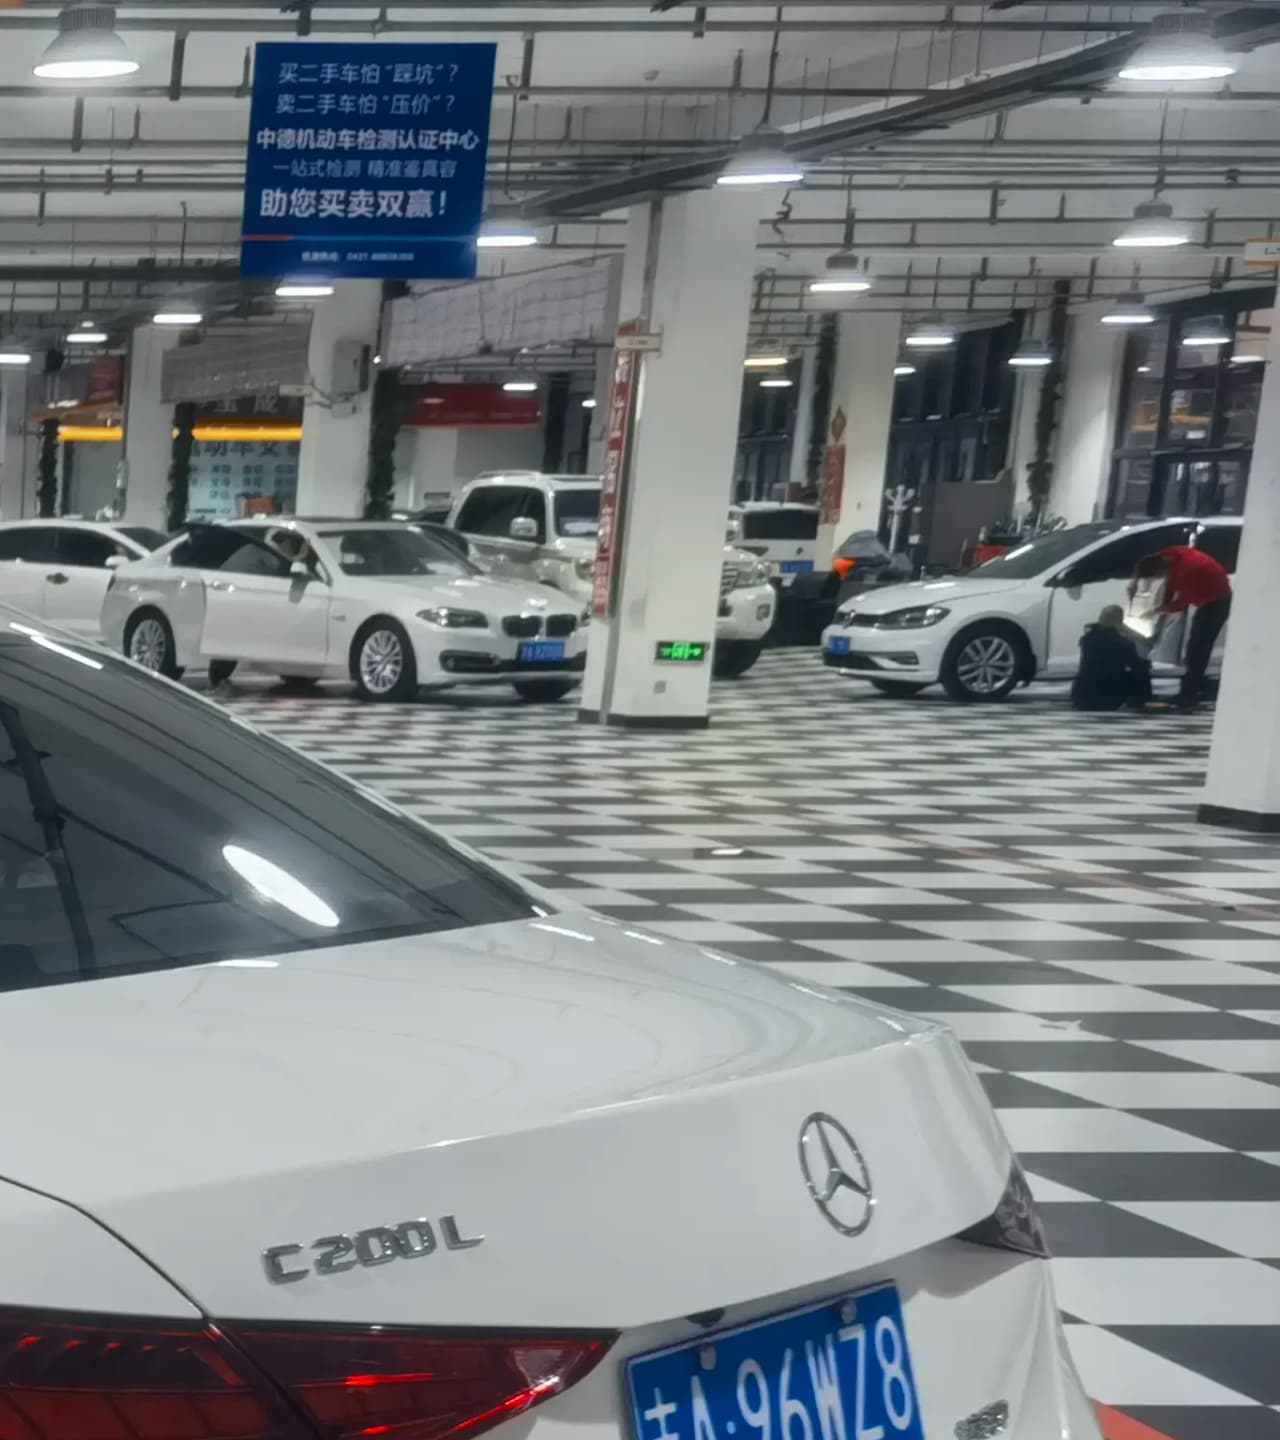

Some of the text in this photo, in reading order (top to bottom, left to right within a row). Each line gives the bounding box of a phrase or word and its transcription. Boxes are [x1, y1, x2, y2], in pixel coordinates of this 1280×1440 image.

[256, 128, 480, 151] 中德机动车检测认证中心
